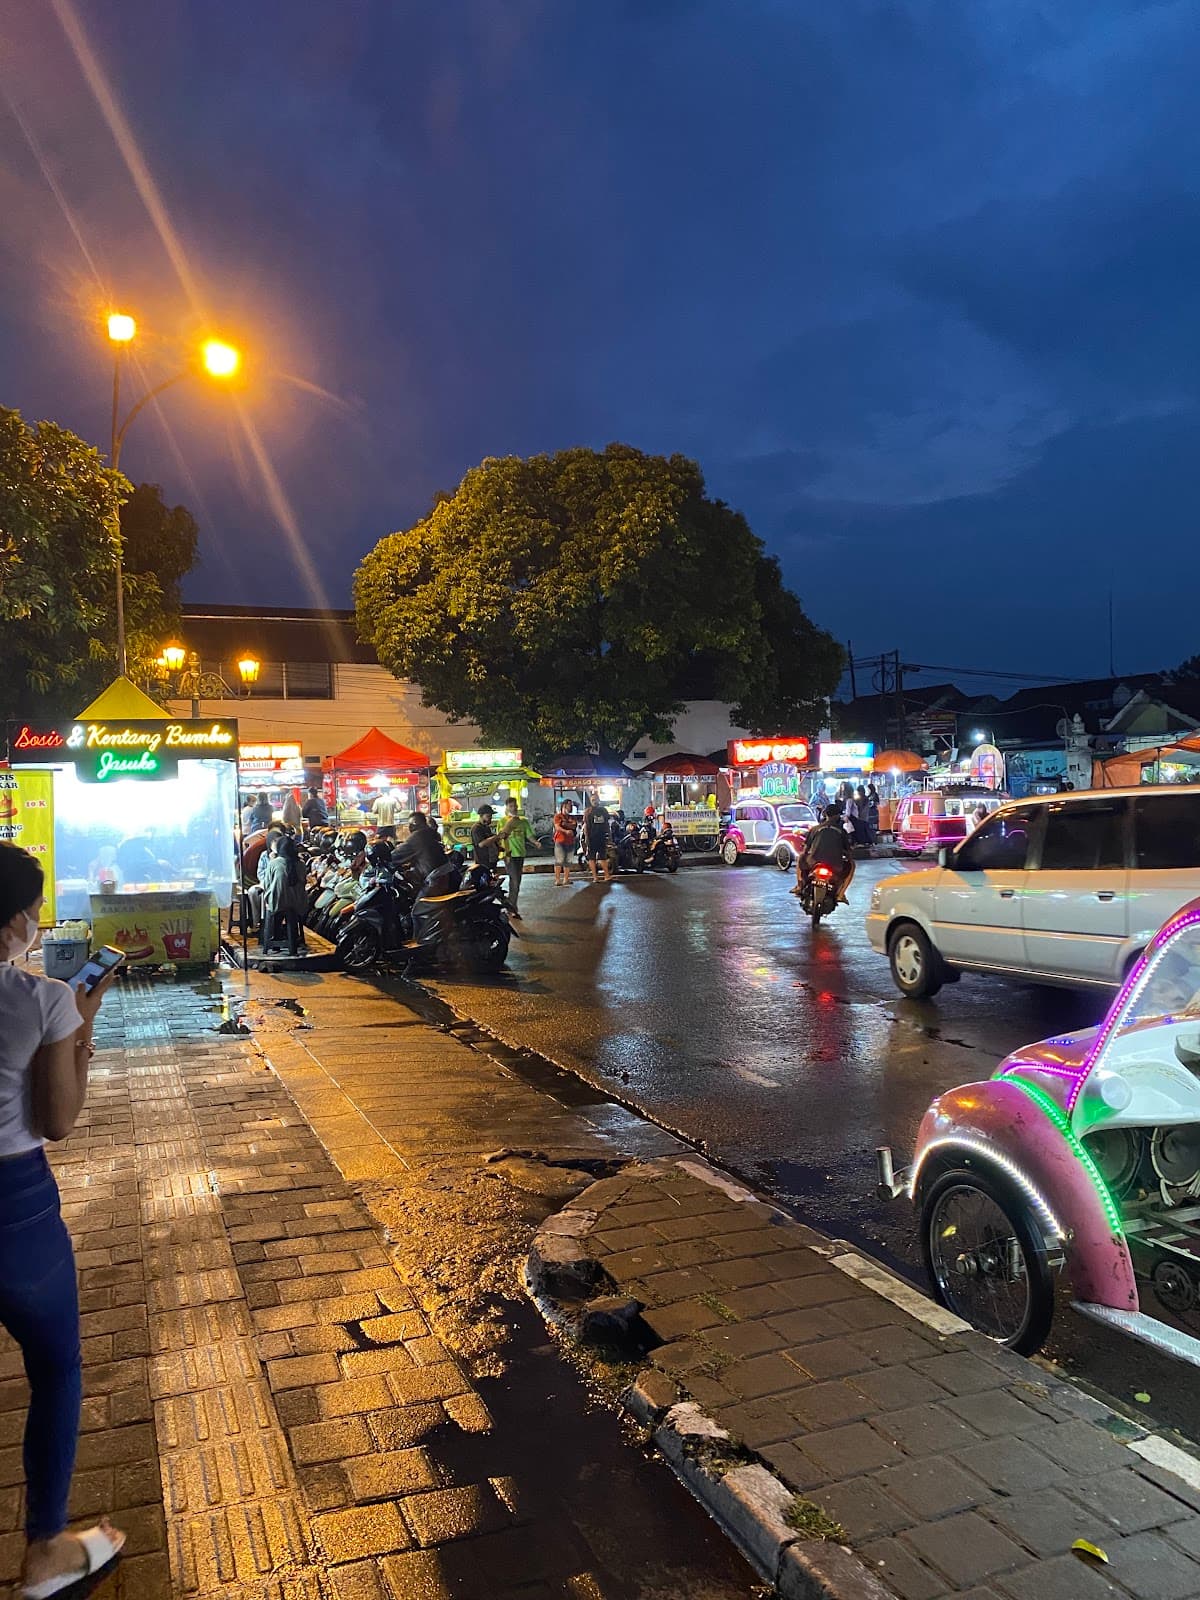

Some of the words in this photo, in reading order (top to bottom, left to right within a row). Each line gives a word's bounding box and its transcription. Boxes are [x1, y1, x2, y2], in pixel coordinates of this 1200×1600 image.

[14, 727, 63, 748] Sosis
[66, 725, 83, 748] &
[87, 724, 161, 751] Kentang
[166, 724, 232, 746] Bumbu
[97, 751, 156, 780] Jasuke
[759, 776, 799, 797] JOGJA
